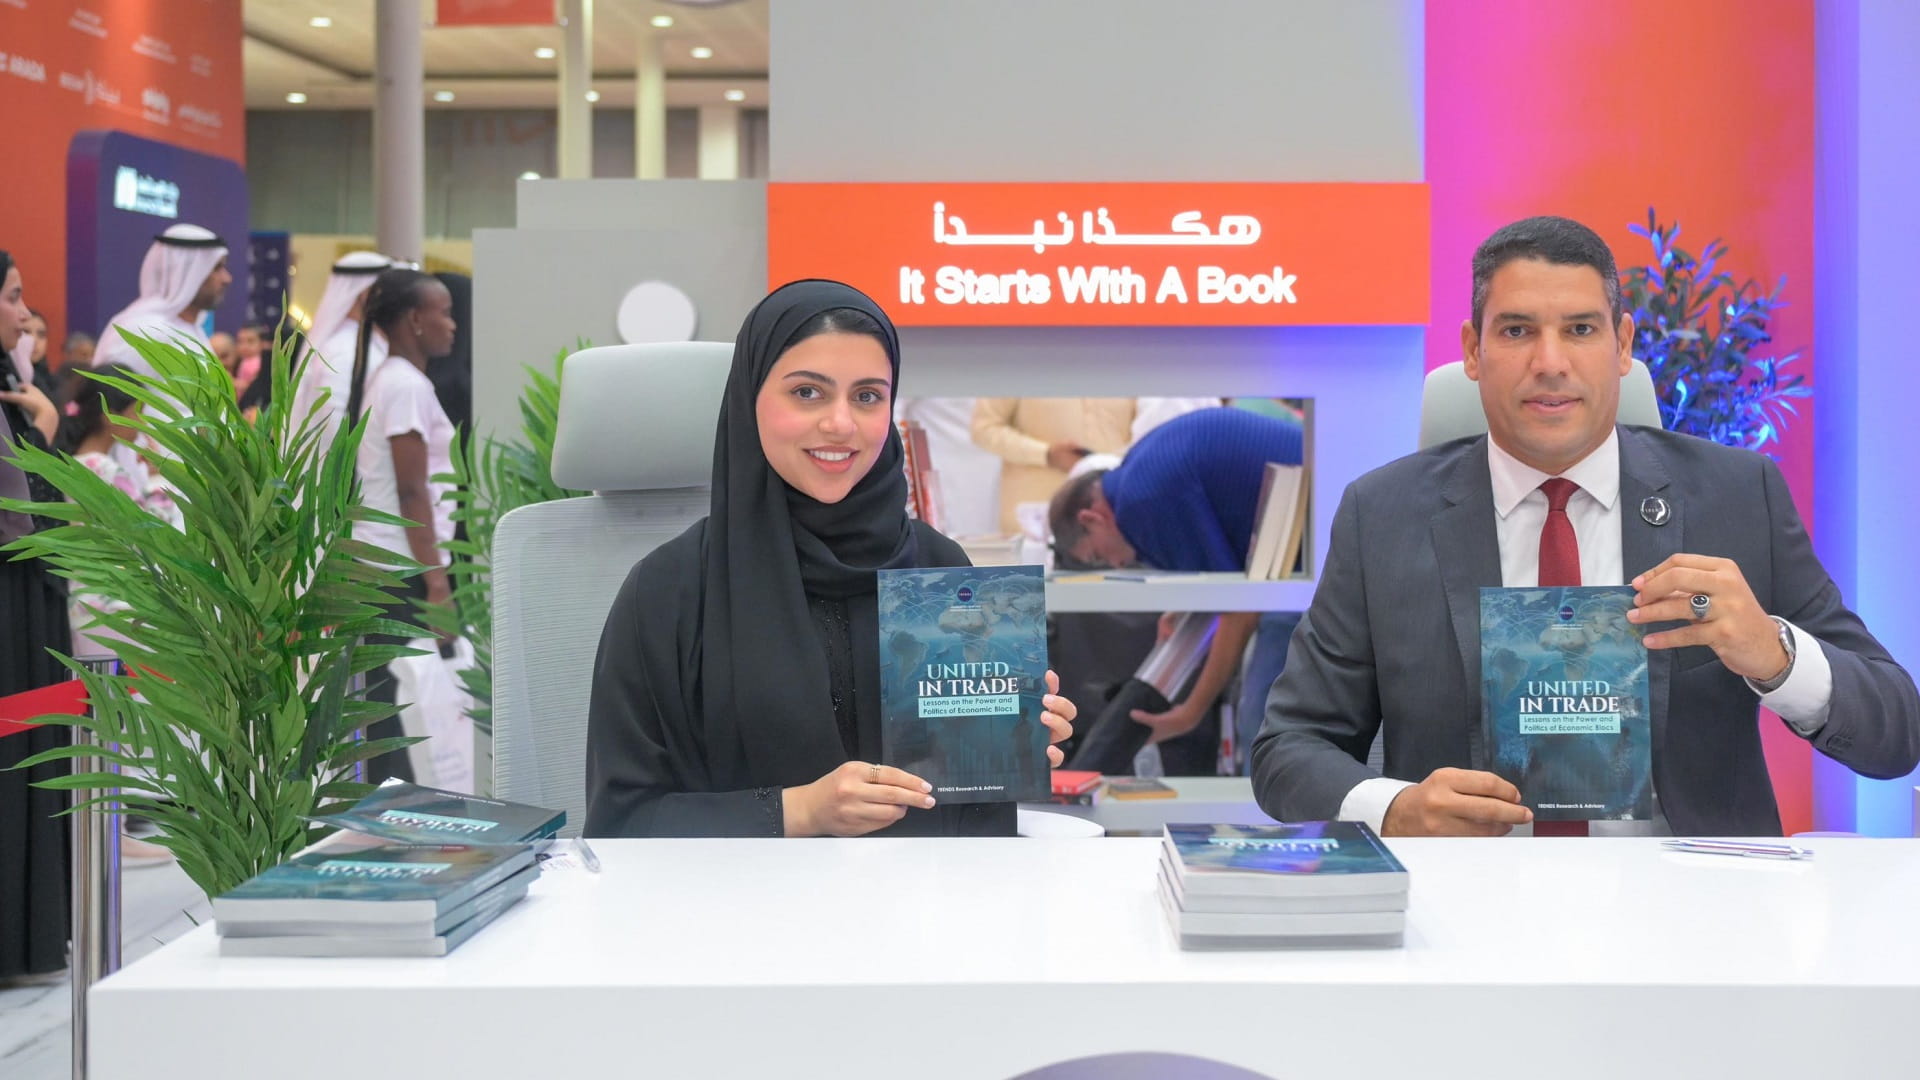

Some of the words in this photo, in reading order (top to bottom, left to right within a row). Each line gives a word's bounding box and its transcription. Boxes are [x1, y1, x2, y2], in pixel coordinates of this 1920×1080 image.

[933, 201, 1075, 255] نبدأ
[1082, 207, 1262, 246] هكذا
[899, 266, 925, 304] It
[934, 266, 1052, 305] Starts
[1057, 266, 1146, 304] With
[1154, 266, 1189, 304] A
[1197, 266, 1298, 304] Book
[927, 661, 1010, 680] UNITED
[918, 680, 942, 697] IN
[947, 677, 1019, 696] TRADE
[1528, 680, 1610, 697] UNITED
[923, 699, 950, 707] Lessons
[962, 697, 974, 705] the
[975, 697, 997, 705] Power
[958, 706, 993, 714] Economic
[1519, 697, 1543, 713] IN
[1548, 696, 1620, 713] TRADE
